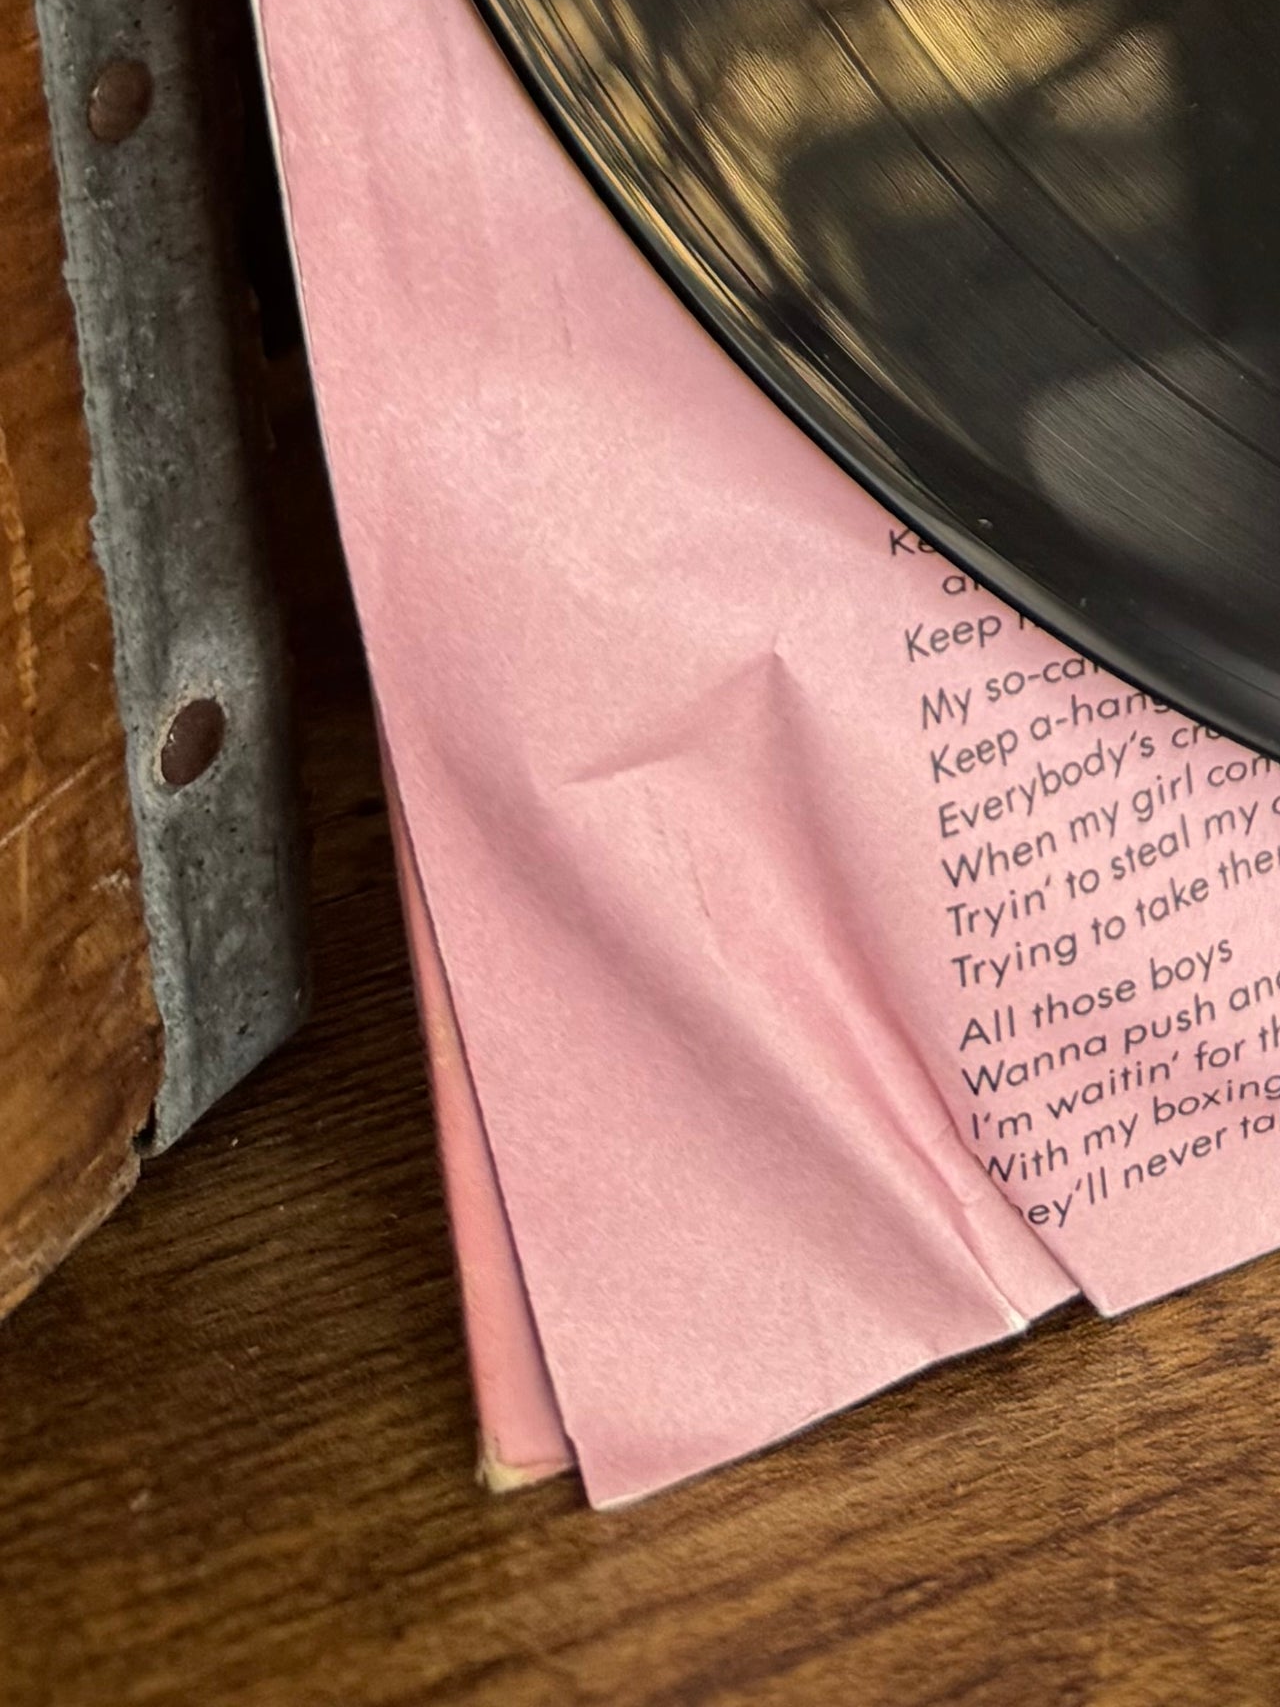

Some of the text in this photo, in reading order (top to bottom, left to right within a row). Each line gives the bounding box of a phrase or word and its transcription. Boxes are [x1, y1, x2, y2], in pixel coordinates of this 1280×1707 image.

[959, 939, 1233, 1051] All those boys
[961, 1035, 1107, 1096] Wanna
[1123, 993, 1216, 1054] push
[972, 1111, 1033, 1139] I'm
[1047, 1050, 1179, 1119] waitin'
[1195, 1039, 1246, 1071] for
[988, 1139, 1069, 1182] With
[1083, 1113, 1138, 1156] my
[1123, 1127, 1227, 1189] never
